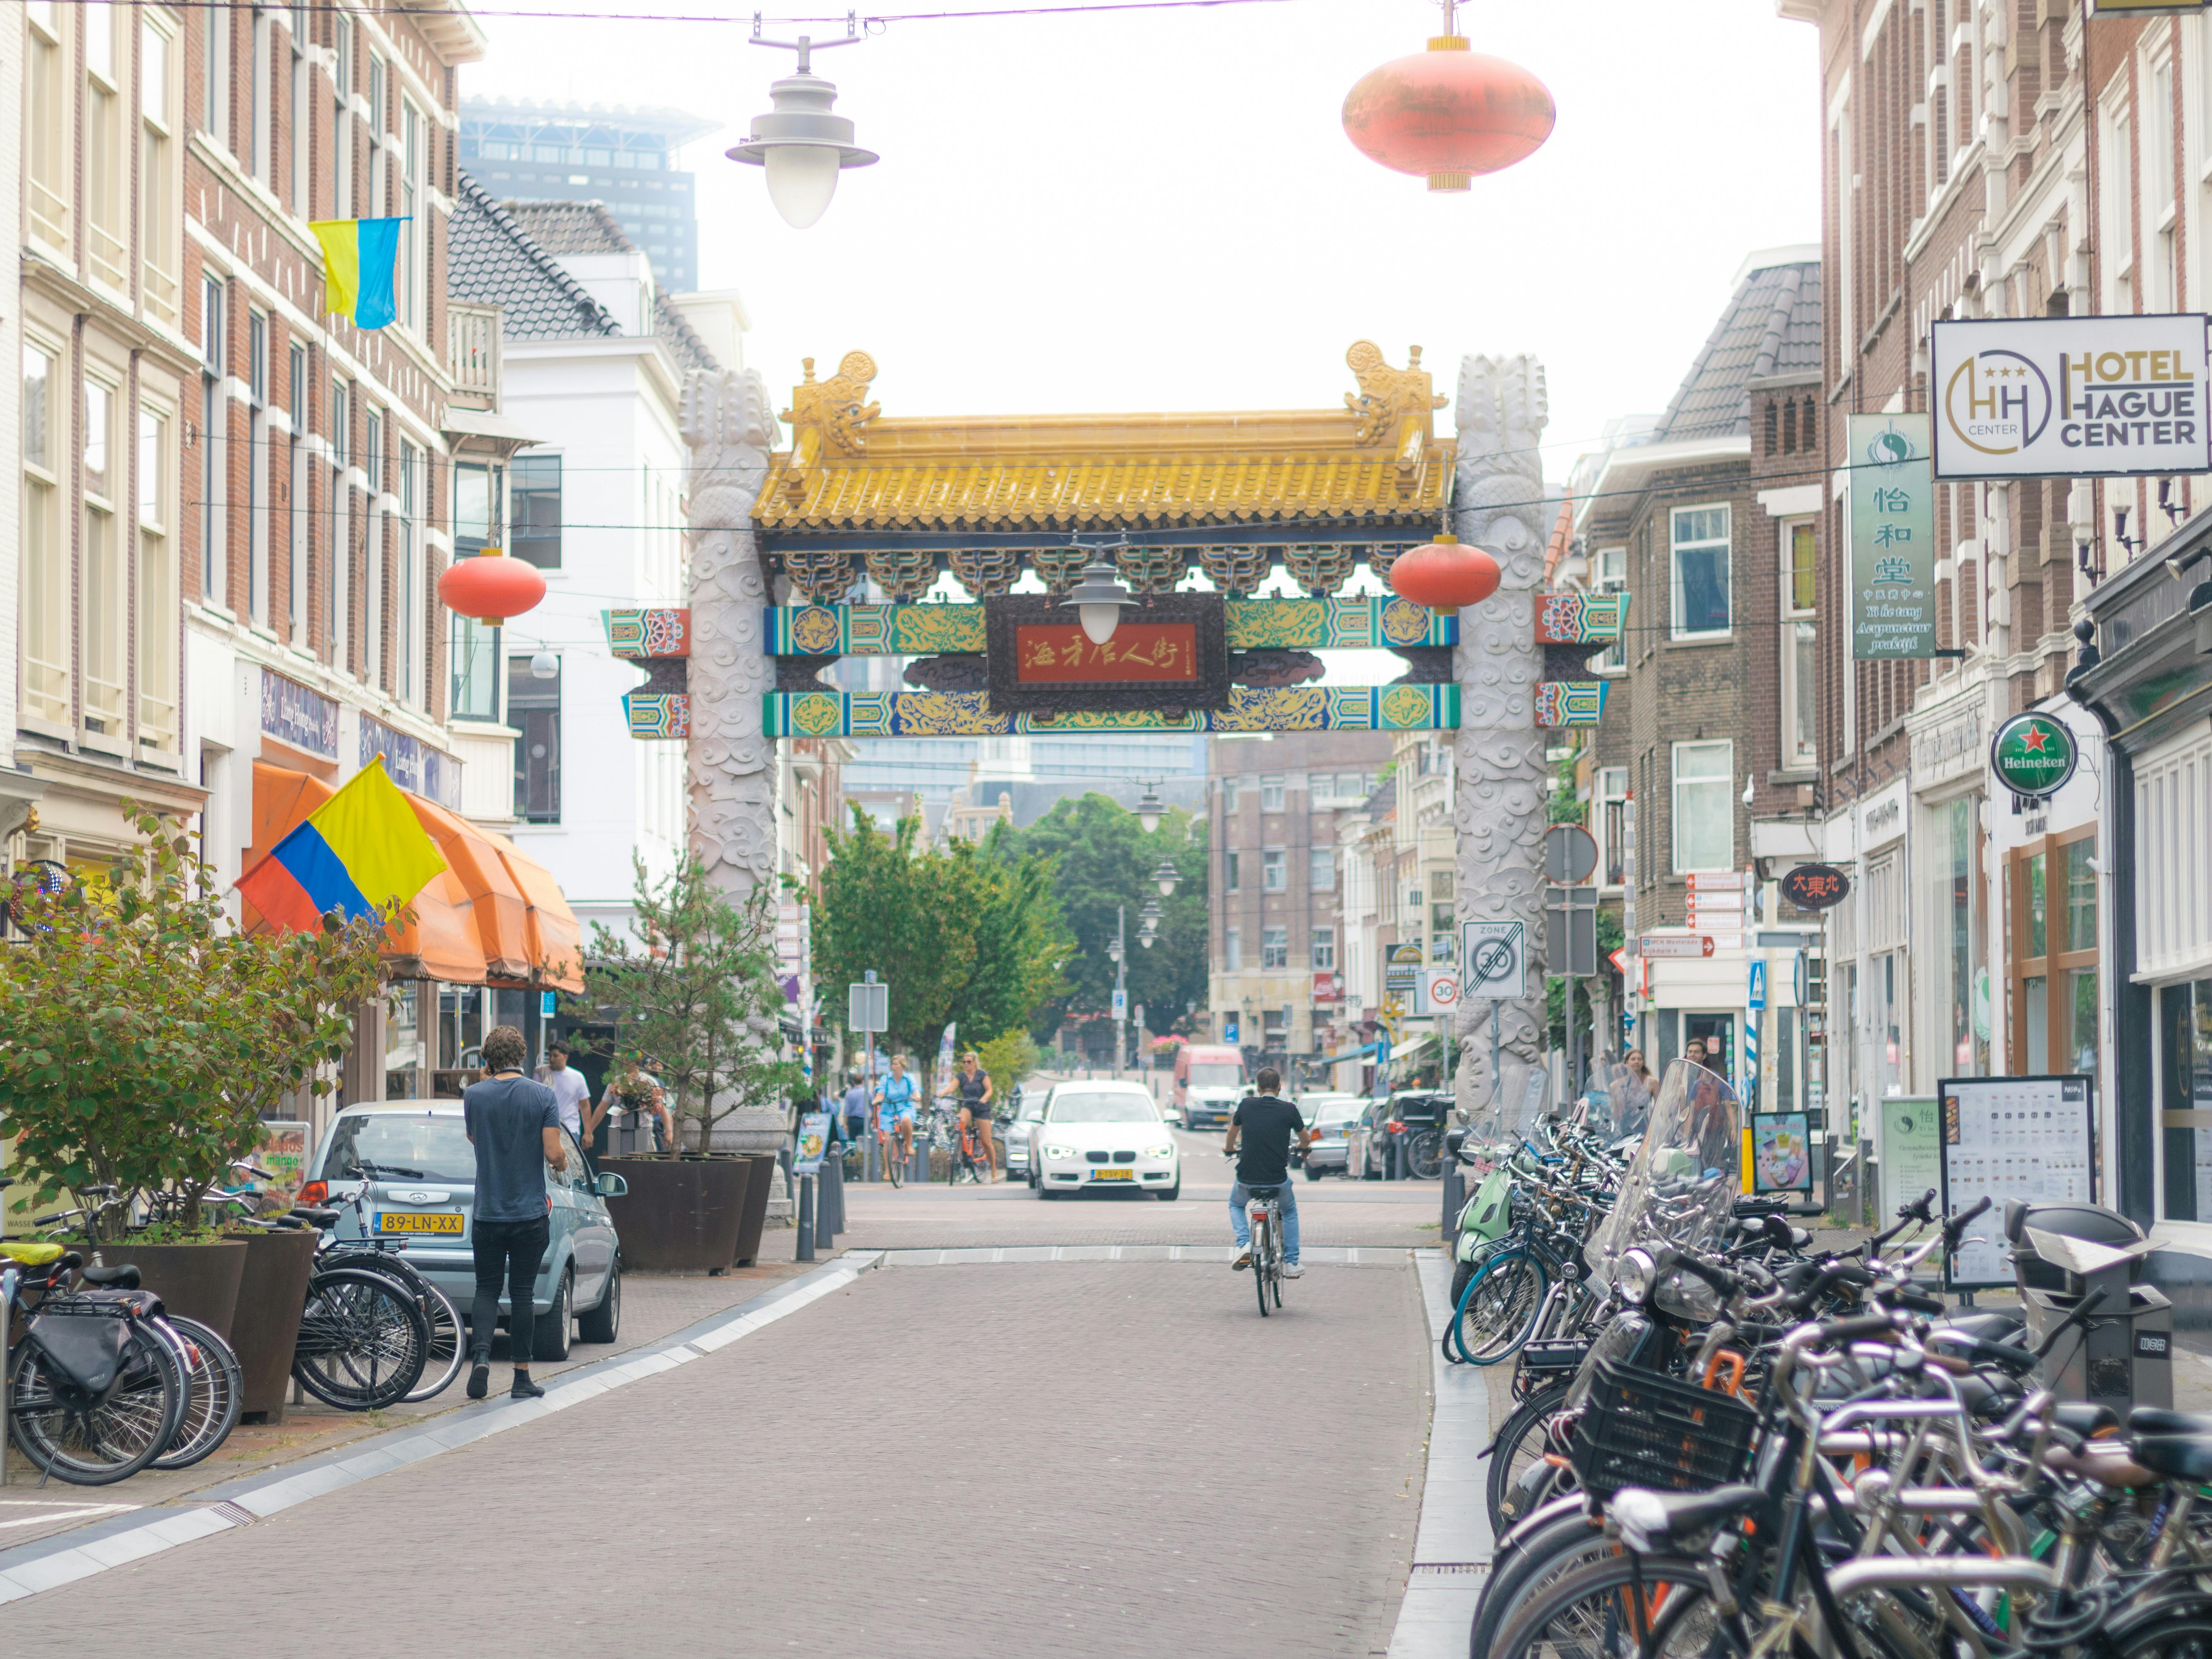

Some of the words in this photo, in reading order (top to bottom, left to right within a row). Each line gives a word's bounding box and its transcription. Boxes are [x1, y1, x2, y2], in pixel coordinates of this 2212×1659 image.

[2060, 350, 2194, 384] HOTEL
[2060, 391, 2194, 420] HAGUE
[1969, 424, 2017, 435] CENTER
[2061, 420, 2196, 447] CENTER
[1872, 485, 1915, 586] 怡和堂
[1866, 605, 1879, 618] Yi
[1880, 603, 1895, 618] he
[1895, 606, 1922, 622] tang
[1856, 621, 1932, 638] Acupunctuur
[1867, 635, 1918, 654] praktijk
[281, 696, 294, 731] Liang
[294, 703, 309, 737] Hong
[395, 749, 409, 779] Liang
[2004, 756, 2066, 769] Heineken
[1792, 873, 1840, 900] 大東北
[1480, 952, 1508, 969] 30
[1436, 986, 1453, 996] 30
[266, 1156, 299, 1170] mango
[386, 1216, 457, 1230] 89-LN-XX
